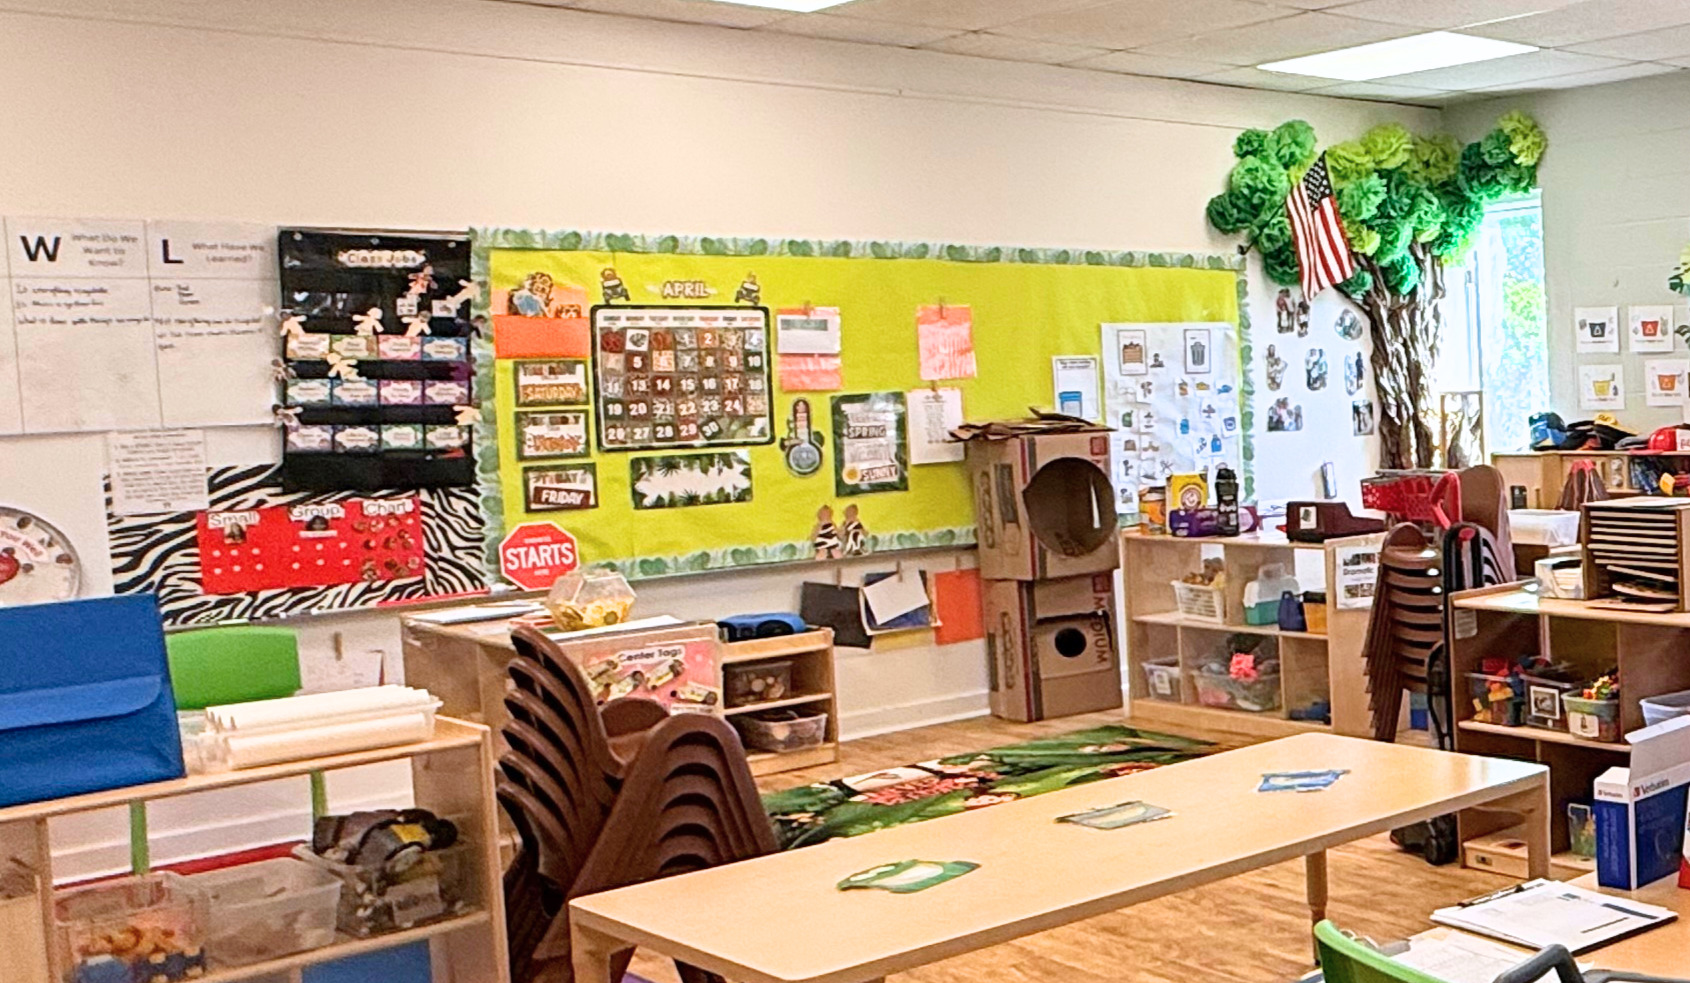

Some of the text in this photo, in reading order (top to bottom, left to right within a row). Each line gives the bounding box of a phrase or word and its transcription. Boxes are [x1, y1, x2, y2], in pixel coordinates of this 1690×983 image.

[20, 235, 61, 262] W
[162, 238, 184, 264] L
[663, 281, 709, 298] APRIL
[704, 333, 712, 344] 2
[633, 356, 642, 368] 5
[748, 356, 761, 367] 10
[657, 379, 671, 390] 14
[681, 379, 695, 390] 15
[703, 378, 716, 390] 16
[607, 404, 622, 415] 19
[629, 403, 647, 415] 20
[679, 402, 697, 416] 22
[725, 400, 742, 411] 24
[633, 427, 650, 440] 27
[656, 426, 673, 438] 28
[679, 424, 697, 437] 29
[702, 421, 719, 437] 30
[849, 426, 886, 438] SPRING
[541, 489, 584, 504] FRIDAY
[293, 505, 340, 520] Group
[365, 501, 407, 514] Chart
[210, 512, 256, 526] Small
[506, 543, 574, 570] STARTS
[619, 646, 682, 662] Center Tags
